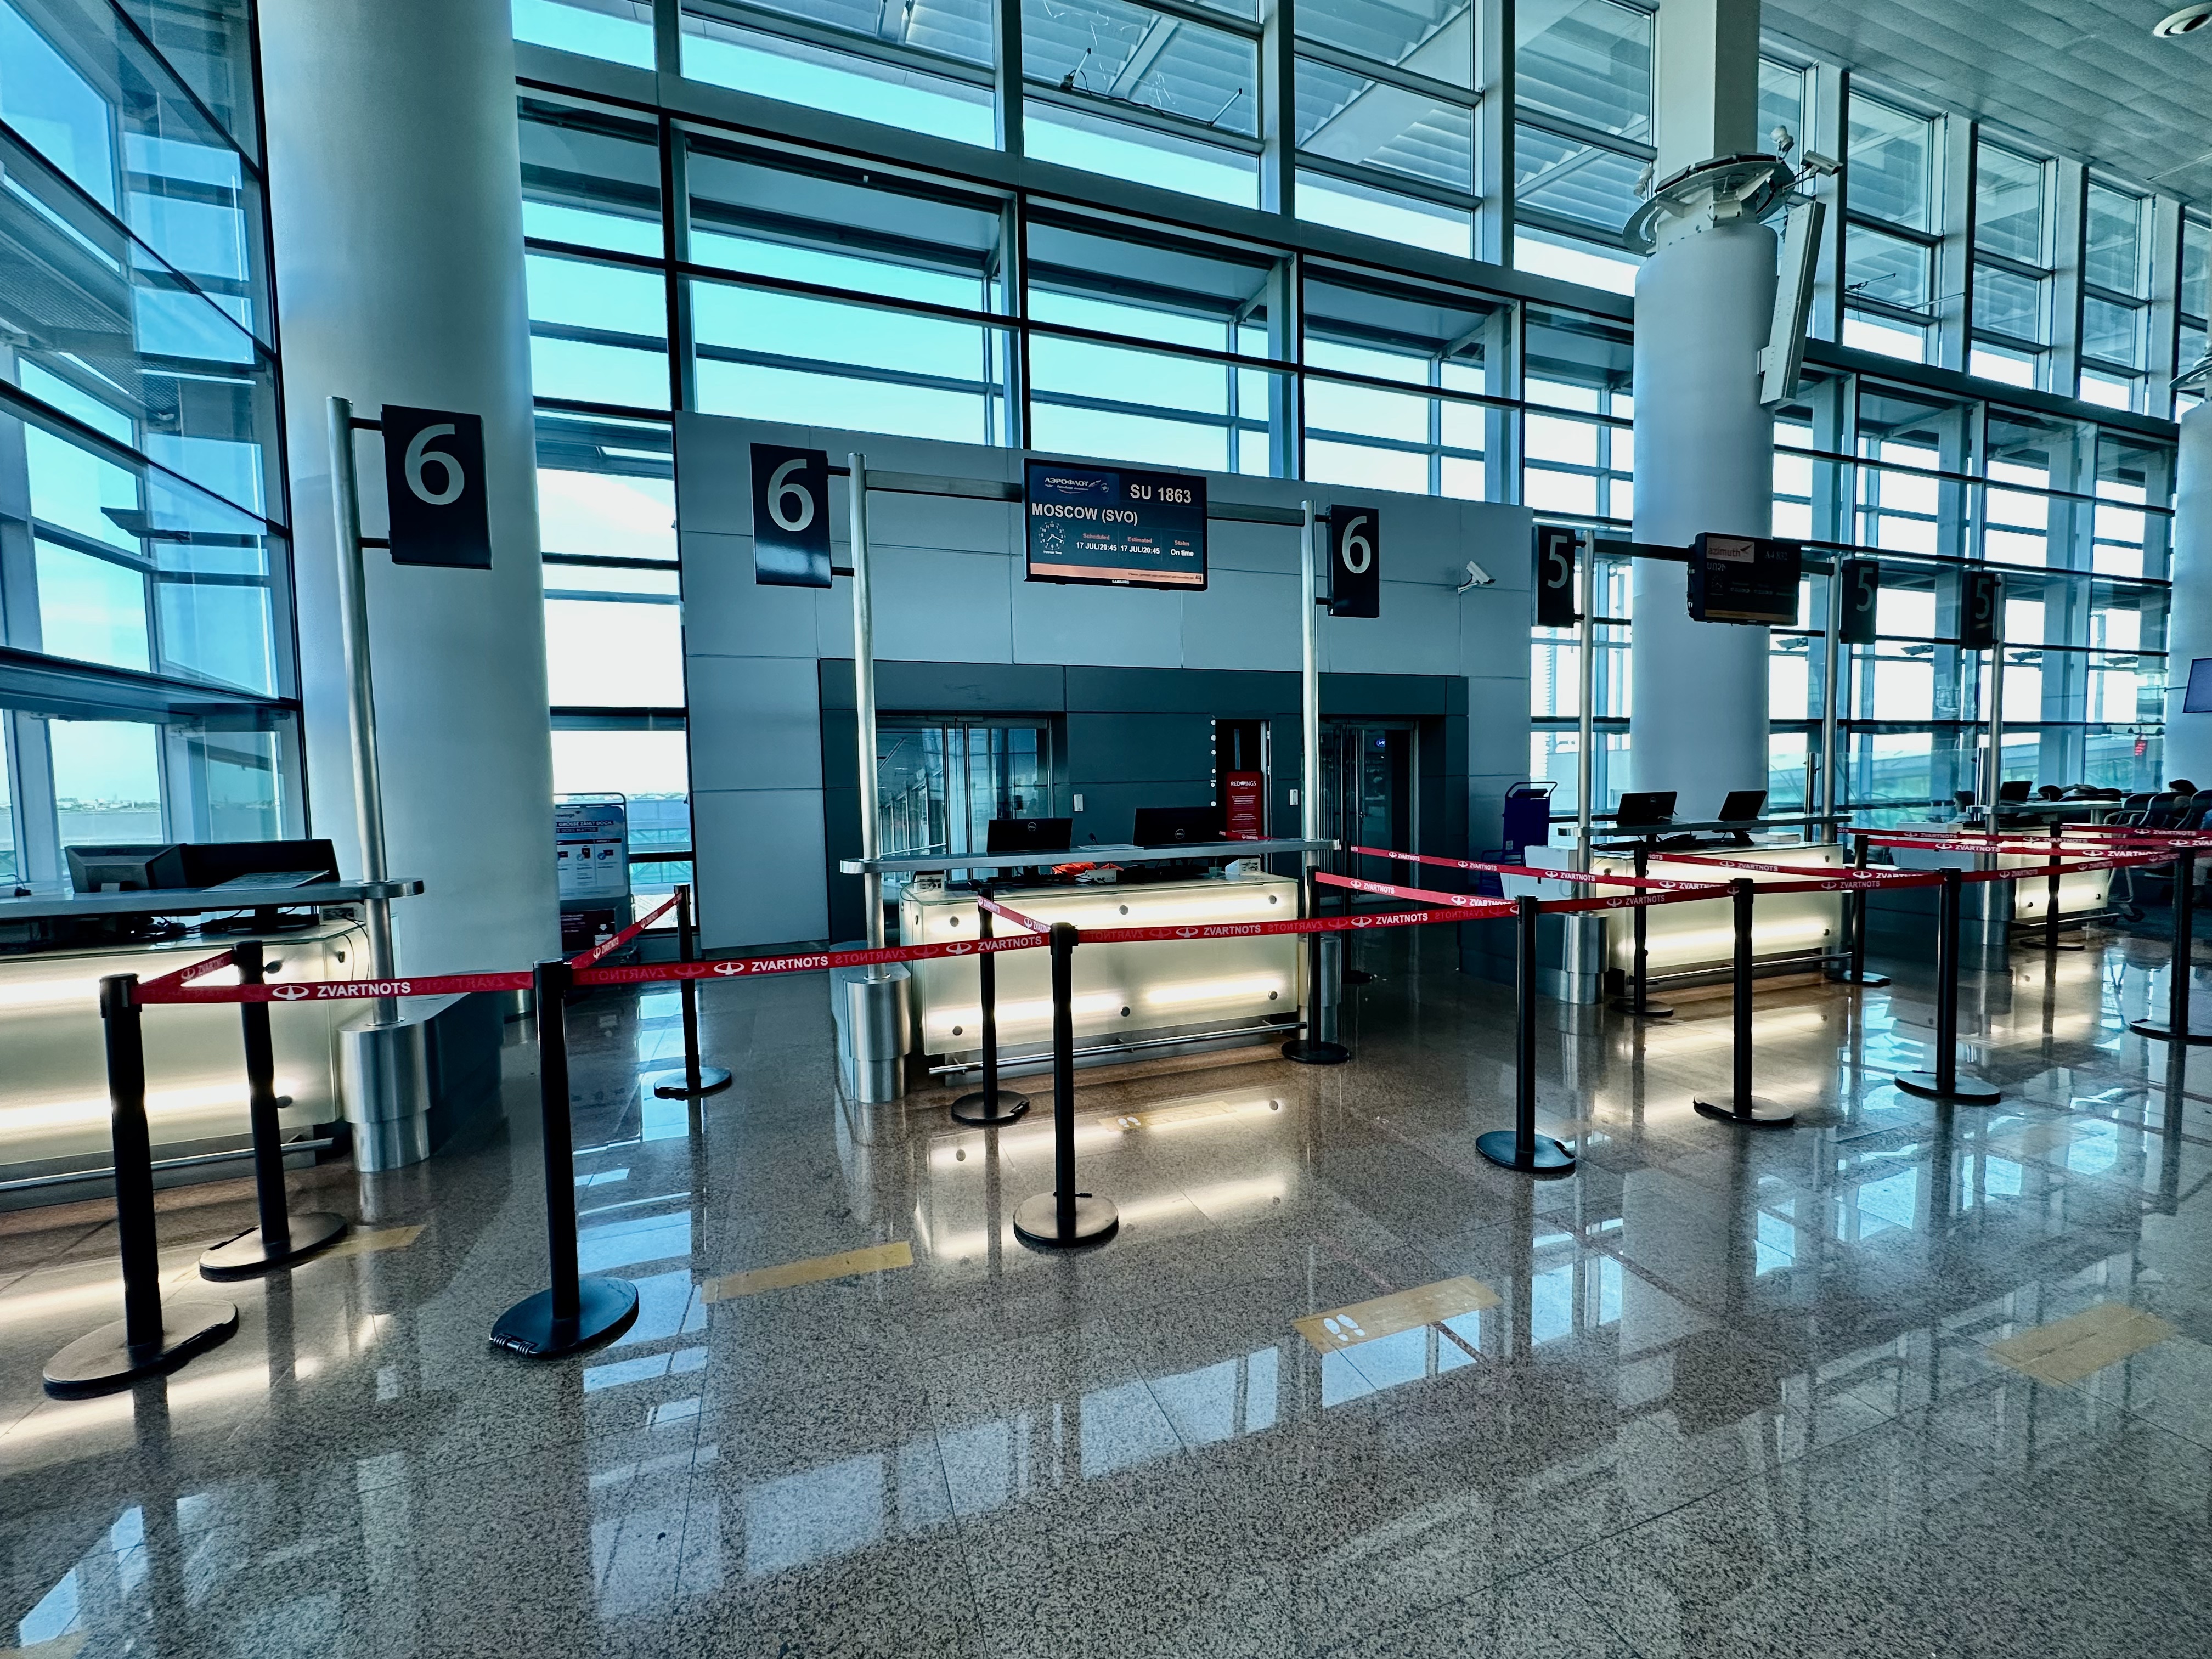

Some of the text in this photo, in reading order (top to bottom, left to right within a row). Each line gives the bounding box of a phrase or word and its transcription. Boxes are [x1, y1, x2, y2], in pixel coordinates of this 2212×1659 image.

[405, 424, 465, 505] 6
[1045, 477, 1088, 487] АЭРОФЛОТ
[768, 459, 814, 532] 6
[1130, 484, 1191, 503] SU 1863
[1031, 503, 1138, 526] MOSCOW (SVO)
[1085, 543, 1117, 551] JUL/20:45
[1129, 546, 1160, 554] JUL/20:45
[1342, 516, 1371, 573] 6
[1708, 547, 1740, 557] azimuth
[1547, 534, 1570, 589] 5
[1856, 567, 1874, 612] 5
[1975, 578, 1990, 619] 5
[1955, 844, 2001, 853] ZVARTNOTS
[1469, 862, 1497, 871] ZVARTNOTS
[1737, 863, 1779, 872] ZVARTNOTS
[1560, 872, 1595, 882] ZVARTNOTS
[1363, 882, 1395, 894] ZVARTNOTS
[1839, 880, 1880, 889] ZVARTNOTS
[1626, 895, 1665, 905] ZVARTNOTS
[1376, 913, 1428, 925] ZVARTNOTS
[1203, 924, 1261, 936] ZVARTNOTS
[978, 936, 1042, 951] ZVARTNOTS
[752, 956, 828, 972] ZVARTNOTS
[317, 981, 411, 997] ZVARTNOTS
